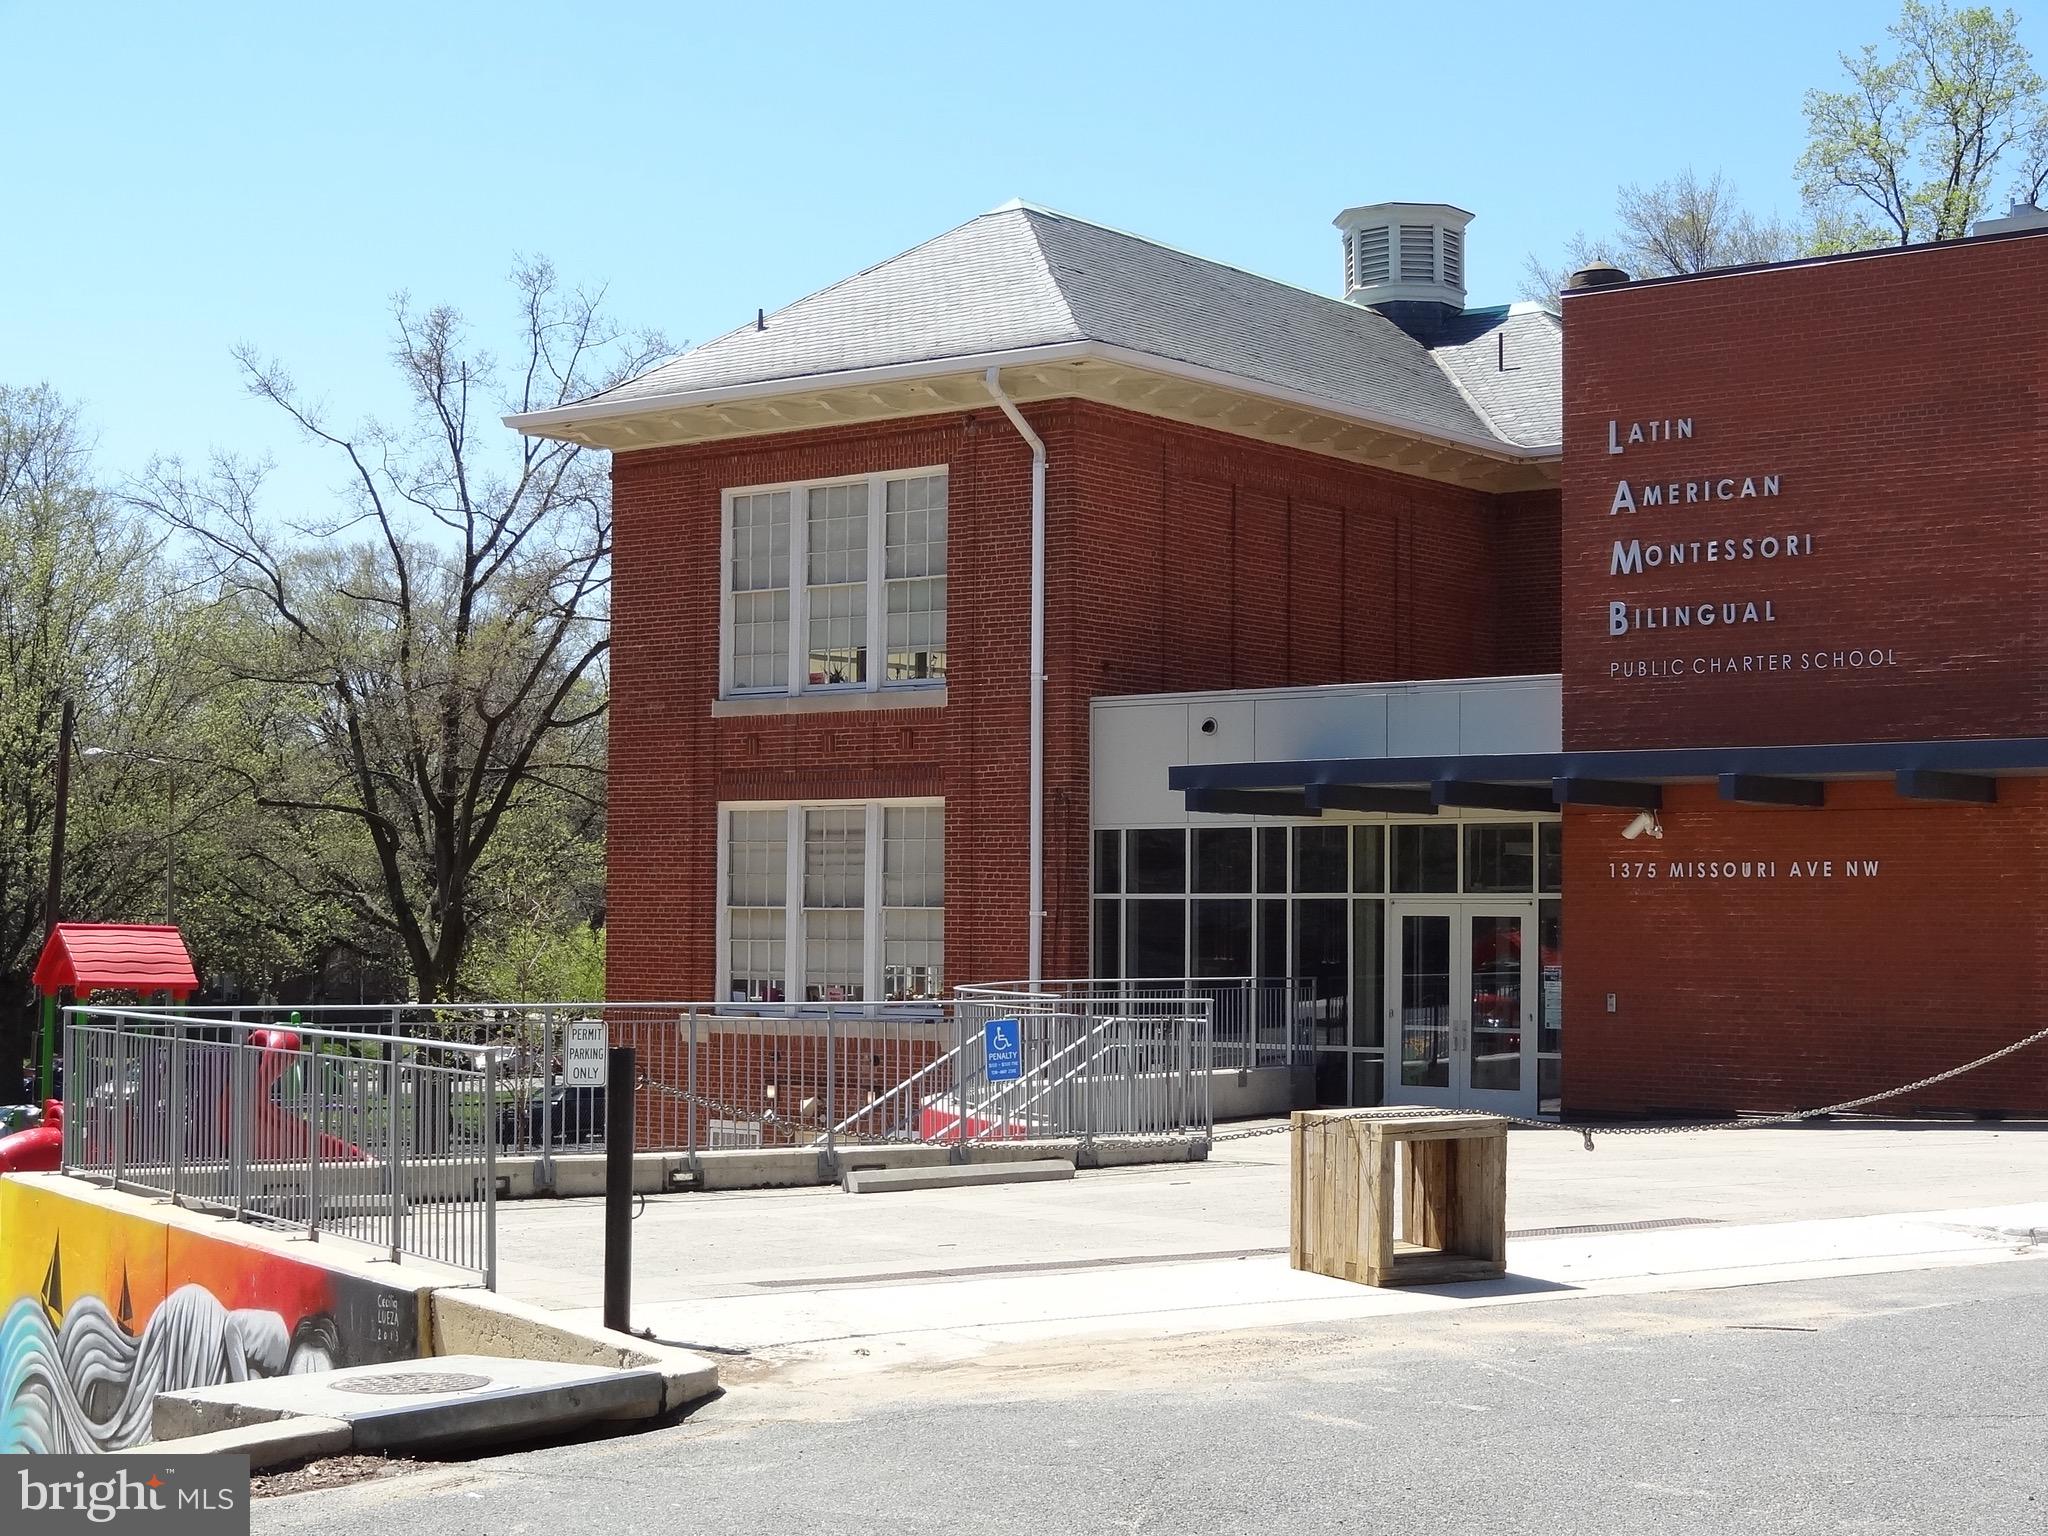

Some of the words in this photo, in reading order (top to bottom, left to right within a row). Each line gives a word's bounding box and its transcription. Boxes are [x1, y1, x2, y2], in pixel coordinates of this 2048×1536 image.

[1610, 658, 1685, 678] PUBLIC
[1692, 653, 1793, 675] CHARTER
[1800, 648, 1897, 670] SCHOOL
[1608, 862, 1657, 878] 1375
[1669, 861, 1776, 878] MISSOURI
[1789, 860, 1833, 877] AVE
[1846, 860, 1880, 877] NW
[571, 1028, 603, 1041] PERMIT
[569, 1047, 604, 1060] PARKING
[988, 1051, 1018, 1061] PENALTY
[572, 1066, 599, 1079] ONLY
